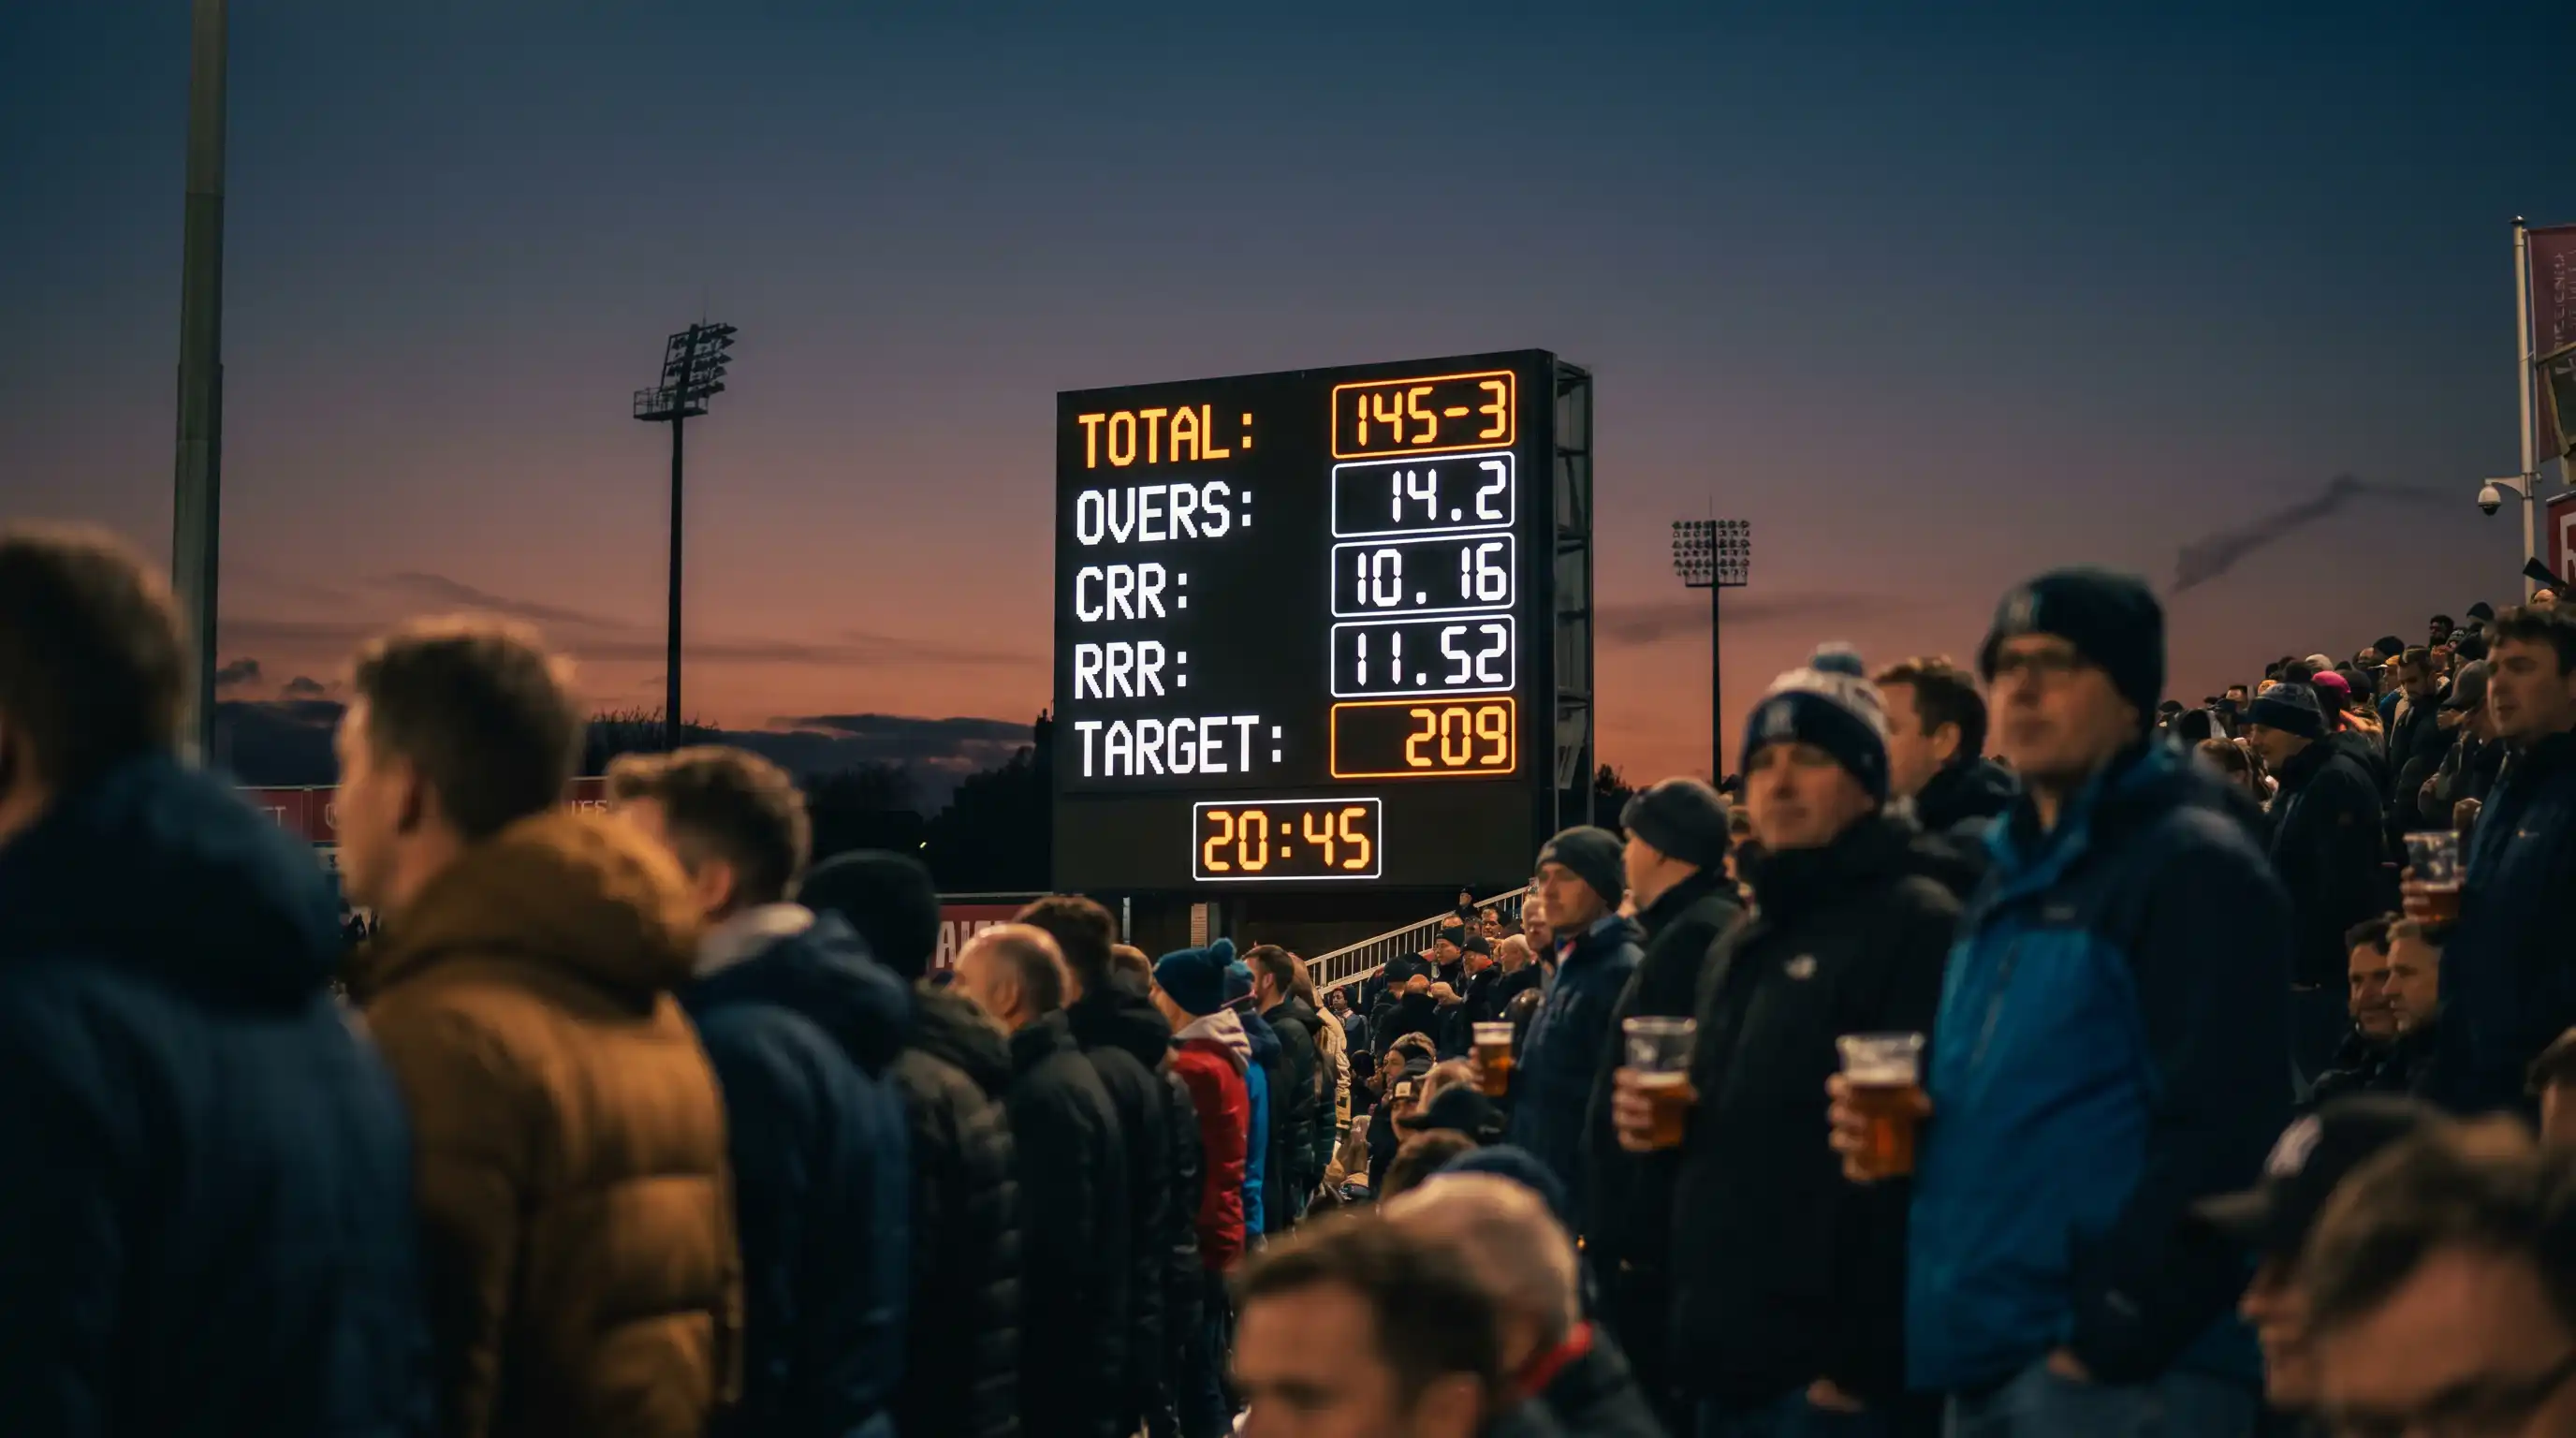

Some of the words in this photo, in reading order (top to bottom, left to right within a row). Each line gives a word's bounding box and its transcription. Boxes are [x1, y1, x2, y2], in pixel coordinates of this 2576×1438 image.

[1079, 404, 1251, 468] TOTAL:
[1358, 380, 1506, 447] 145-3
[1077, 481, 1251, 545] OVERS:
[1393, 461, 1506, 522] 14.2
[1076, 563, 1187, 622] CRR:
[1075, 640, 1186, 698] RRR:
[1357, 624, 1507, 686] 11.52
[1075, 715, 1281, 776] TARGET:
[1406, 706, 1506, 767] 209
[1205, 808, 1370, 871] 20:45
